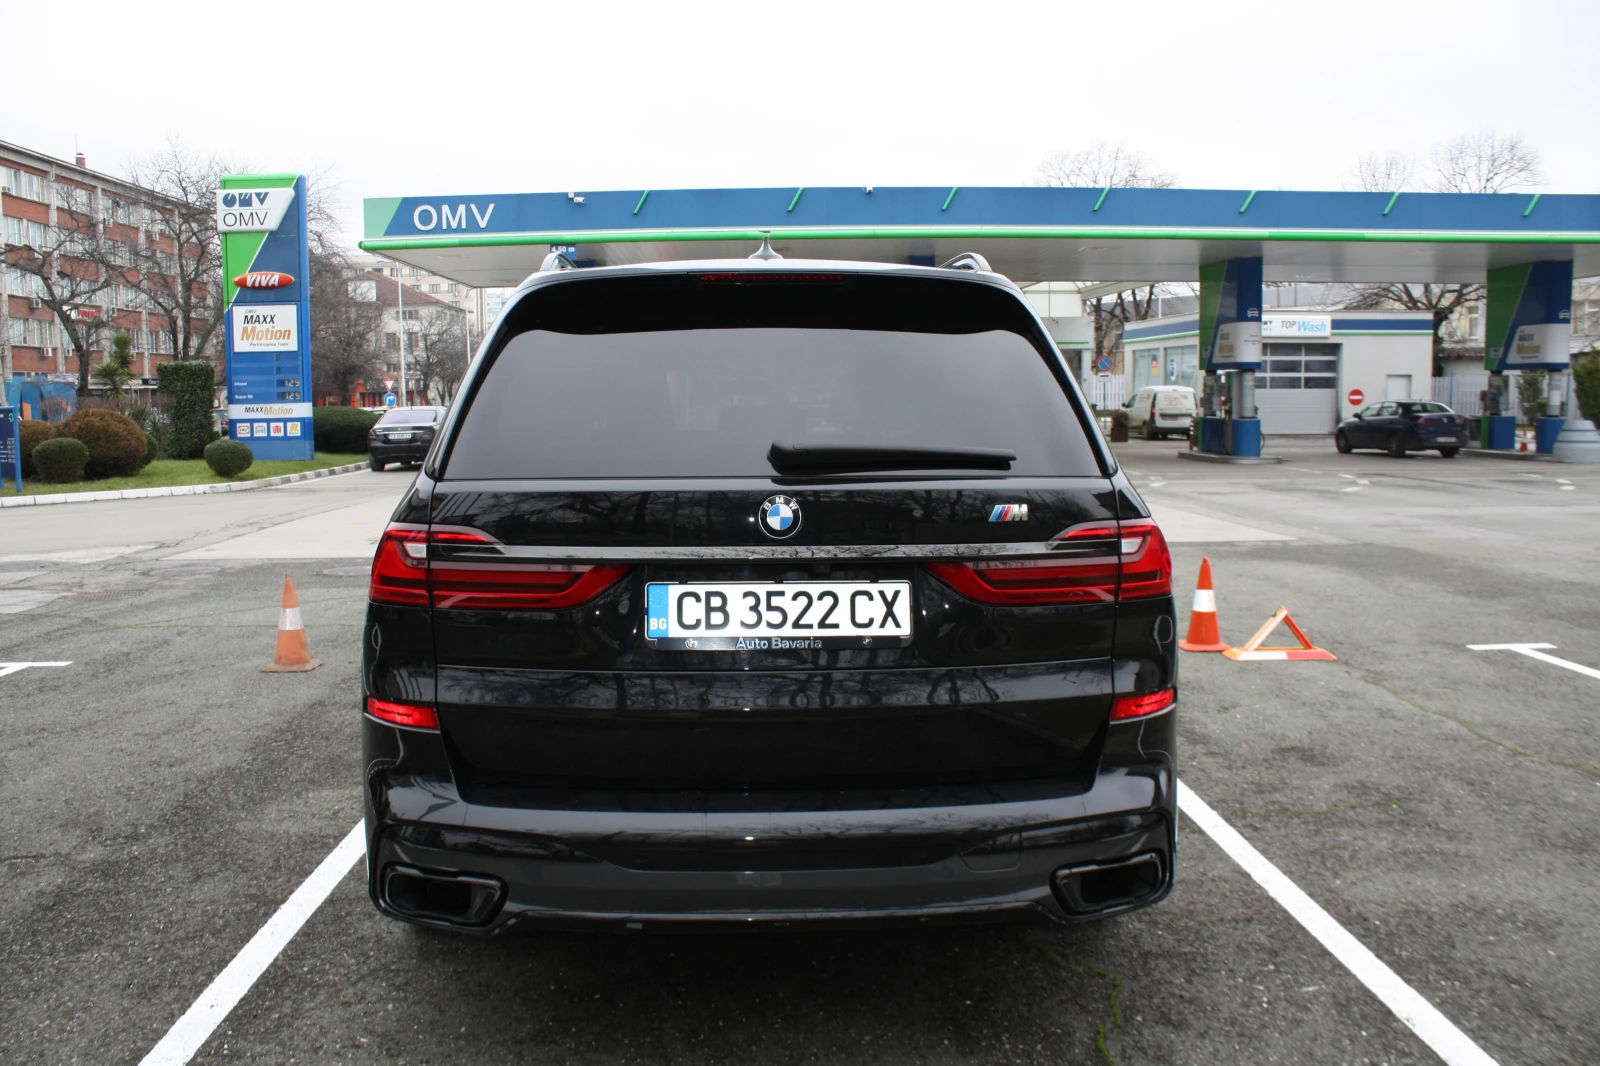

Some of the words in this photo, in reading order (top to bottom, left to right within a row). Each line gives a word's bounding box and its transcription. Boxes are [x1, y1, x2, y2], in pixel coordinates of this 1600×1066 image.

[223, 212, 268, 228] OMV
[412, 203, 495, 232] OMV
[246, 274, 280, 287] VIVA
[244, 314, 276, 324] MAXX
[1281, 320, 1296, 329] TOP
[1297, 320, 1326, 332] Wash
[240, 326, 292, 342] Motion
[763, 496, 798, 510] BMW
[676, 590, 730, 630] CB
[740, 590, 840, 630] 3522
[850, 590, 902, 629] CX
[650, 618, 667, 630] BG
[735, 638, 769, 649] Auto
[772, 637, 822, 649] Bavaria
